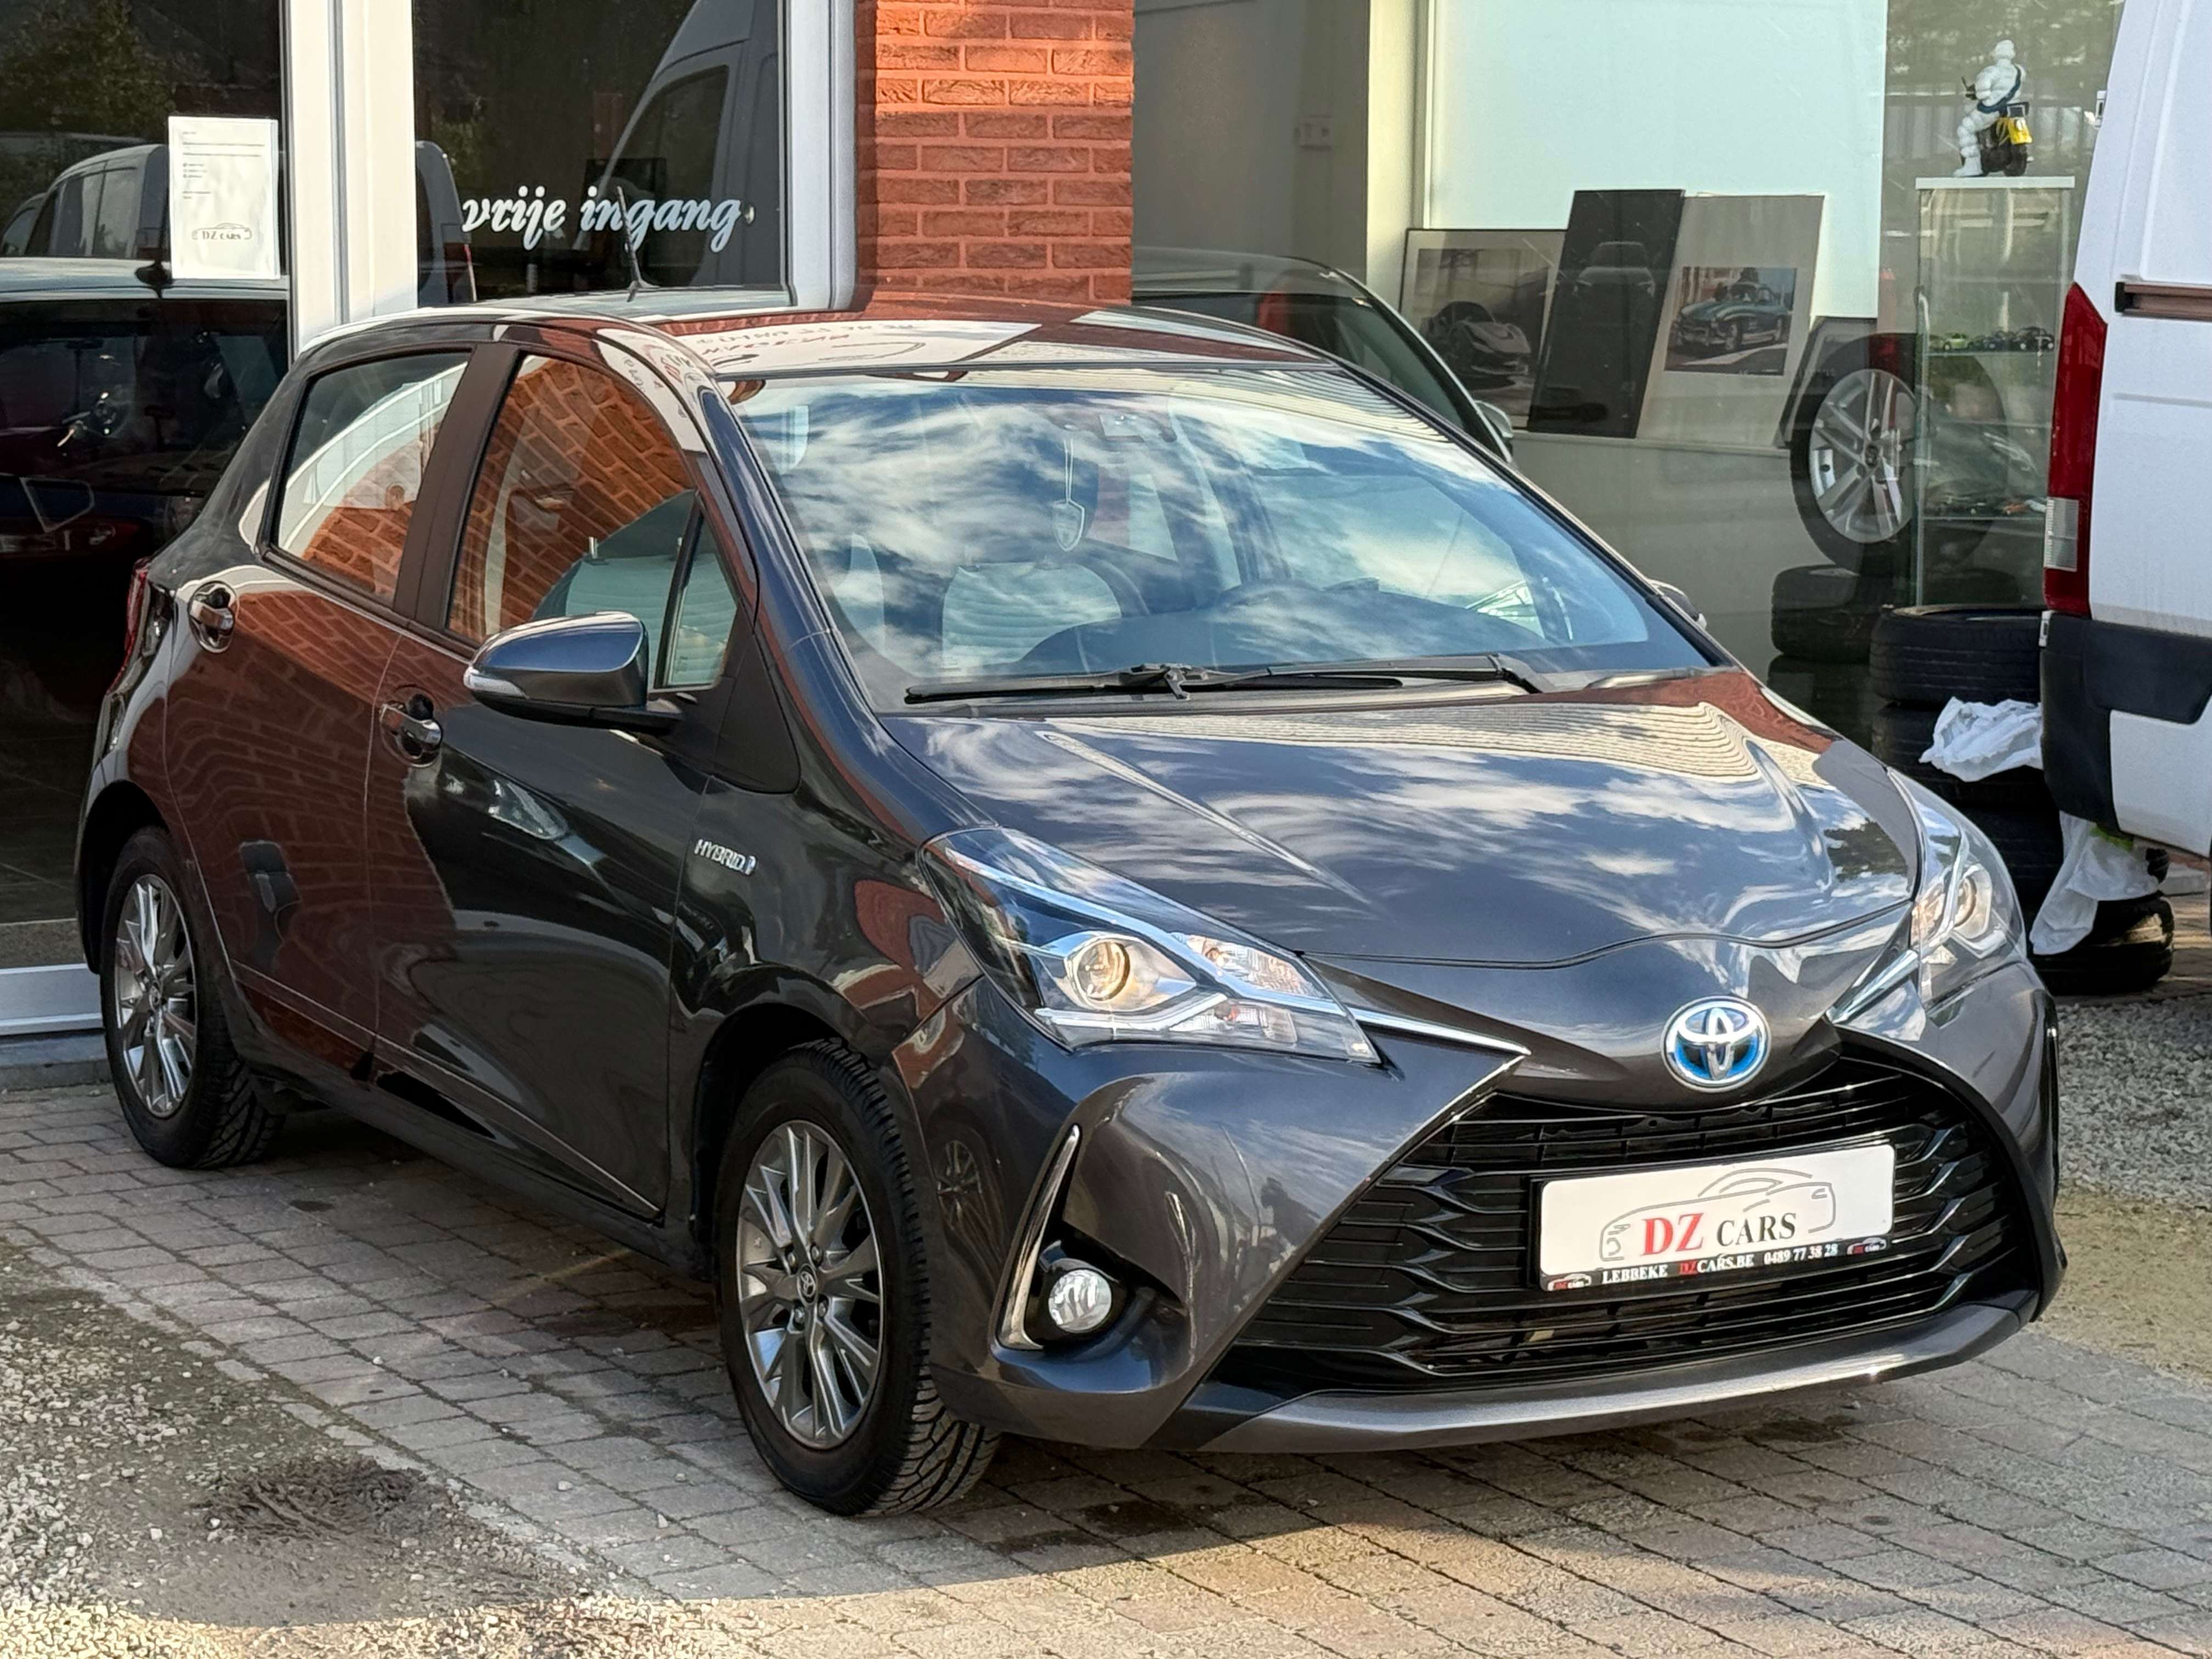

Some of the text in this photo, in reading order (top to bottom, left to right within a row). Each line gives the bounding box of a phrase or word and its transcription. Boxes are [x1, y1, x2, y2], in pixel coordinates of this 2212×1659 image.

[462, 185, 741, 252] vrije ingang
[694, 838, 746, 870] HYBRID
[1640, 1212, 1797, 1256] DZ CARS
[1601, 1263, 1668, 1284] LEBBEKE
[1792, 1246, 1807, 1261] 77
[1824, 1243, 1838, 1257] 28
